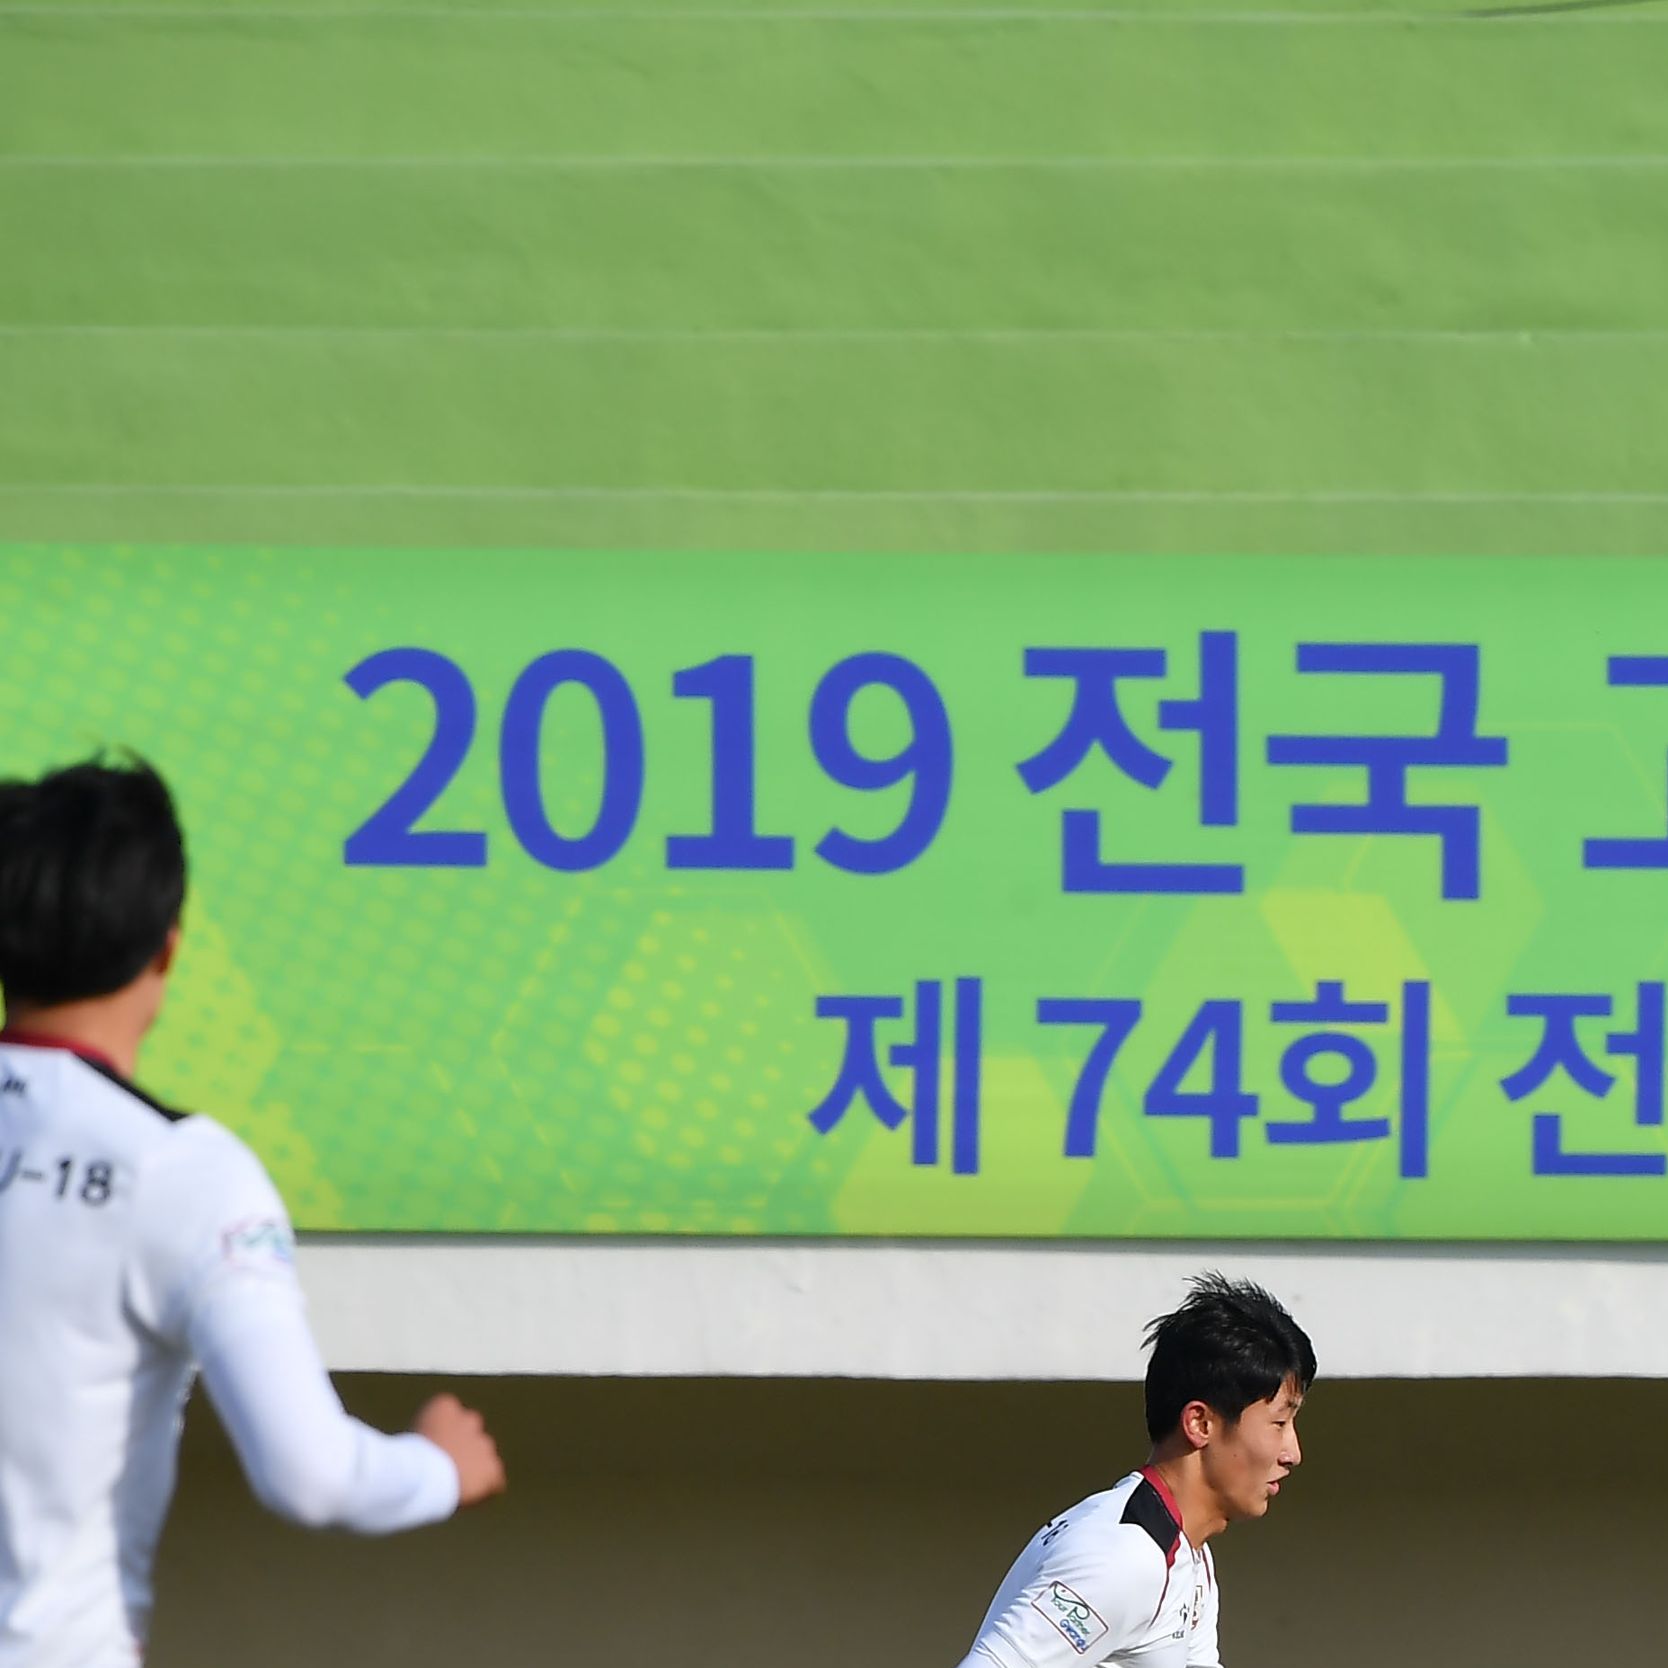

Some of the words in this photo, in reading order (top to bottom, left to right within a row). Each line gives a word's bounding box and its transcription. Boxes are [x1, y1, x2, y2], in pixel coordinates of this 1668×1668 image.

[346, 648, 952, 874] 2019
[1018, 631, 1508, 900] 전국
[809, 978, 982, 1175] 제
[1037, 982, 1429, 1178] 74회
